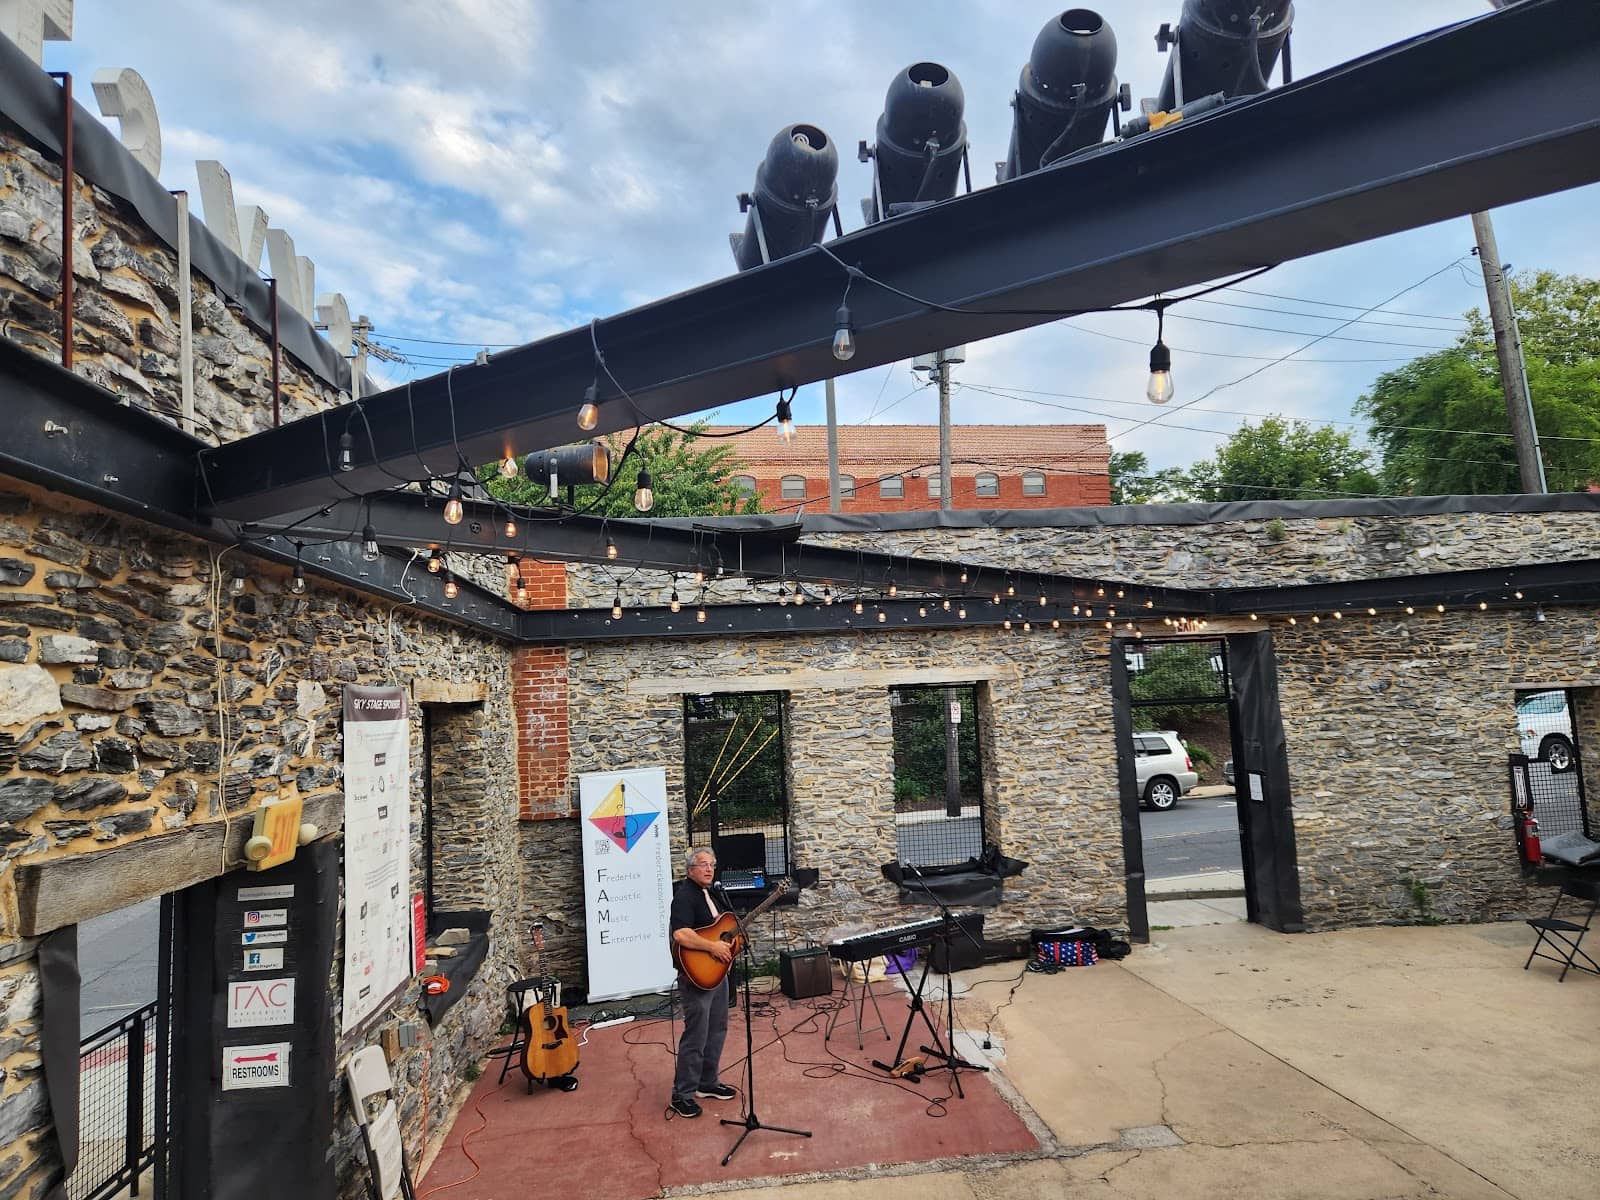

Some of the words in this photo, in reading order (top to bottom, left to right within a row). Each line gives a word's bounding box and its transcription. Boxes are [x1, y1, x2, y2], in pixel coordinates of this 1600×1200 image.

[353, 698, 367, 710] SKY
[366, 699, 383, 710] STAGE
[232, 1064, 279, 1079] RESTROOMS
